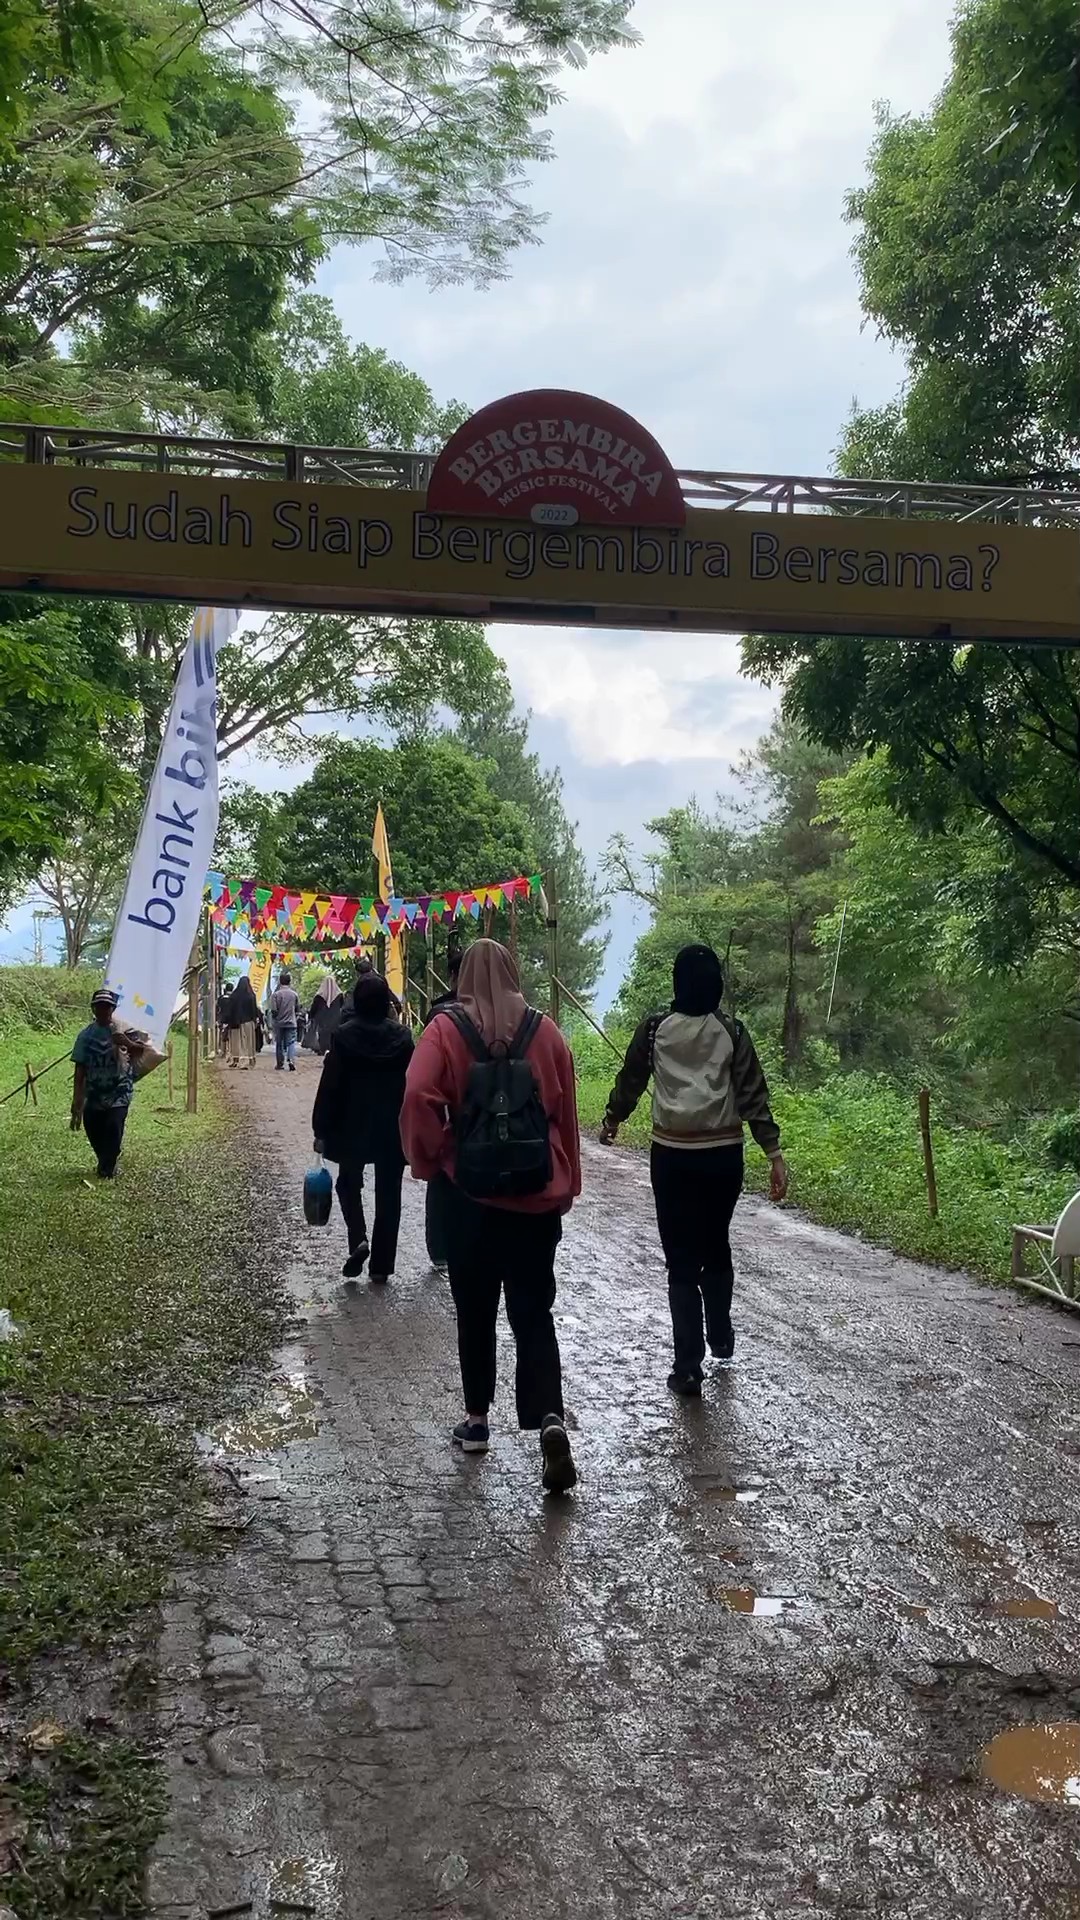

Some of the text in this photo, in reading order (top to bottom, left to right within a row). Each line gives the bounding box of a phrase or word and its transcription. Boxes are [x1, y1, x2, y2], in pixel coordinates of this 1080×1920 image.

[449, 419, 663, 497] BERGEMBIRA
[474, 446, 638, 507] BERSAMA
[498, 475, 619, 514] MUSIC FESTIVAL
[540, 508, 568, 521] 2022
[66, 486, 1000, 592] Sudah Siap Bergembira Bersama?
[127, 800, 200, 934] bank
